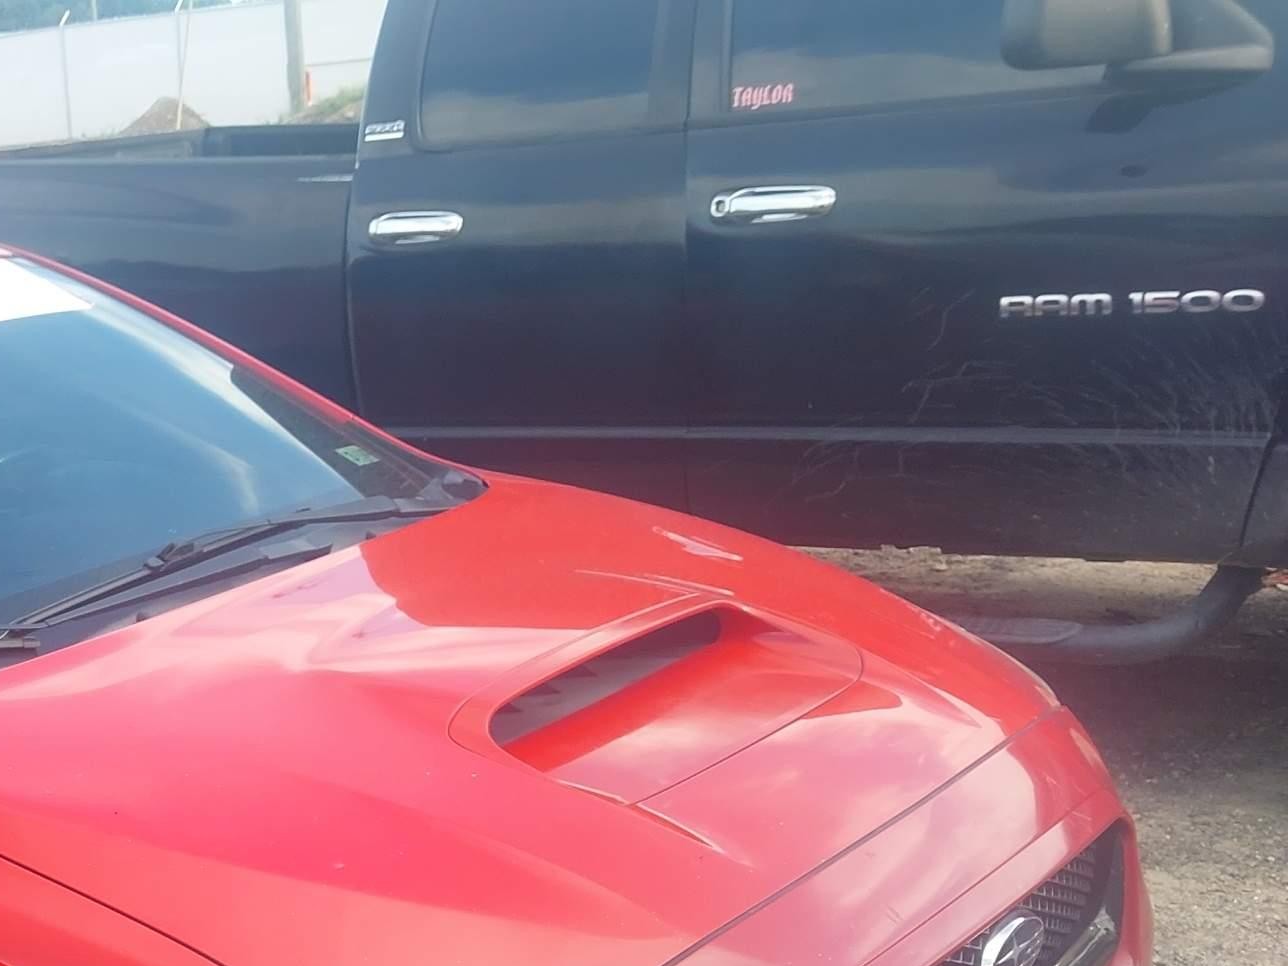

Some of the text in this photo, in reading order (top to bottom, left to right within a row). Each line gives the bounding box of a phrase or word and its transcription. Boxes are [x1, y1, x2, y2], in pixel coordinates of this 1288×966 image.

[732, 83, 794, 110] TAYLOR
[1000, 288, 1265, 318] RAM 1500
